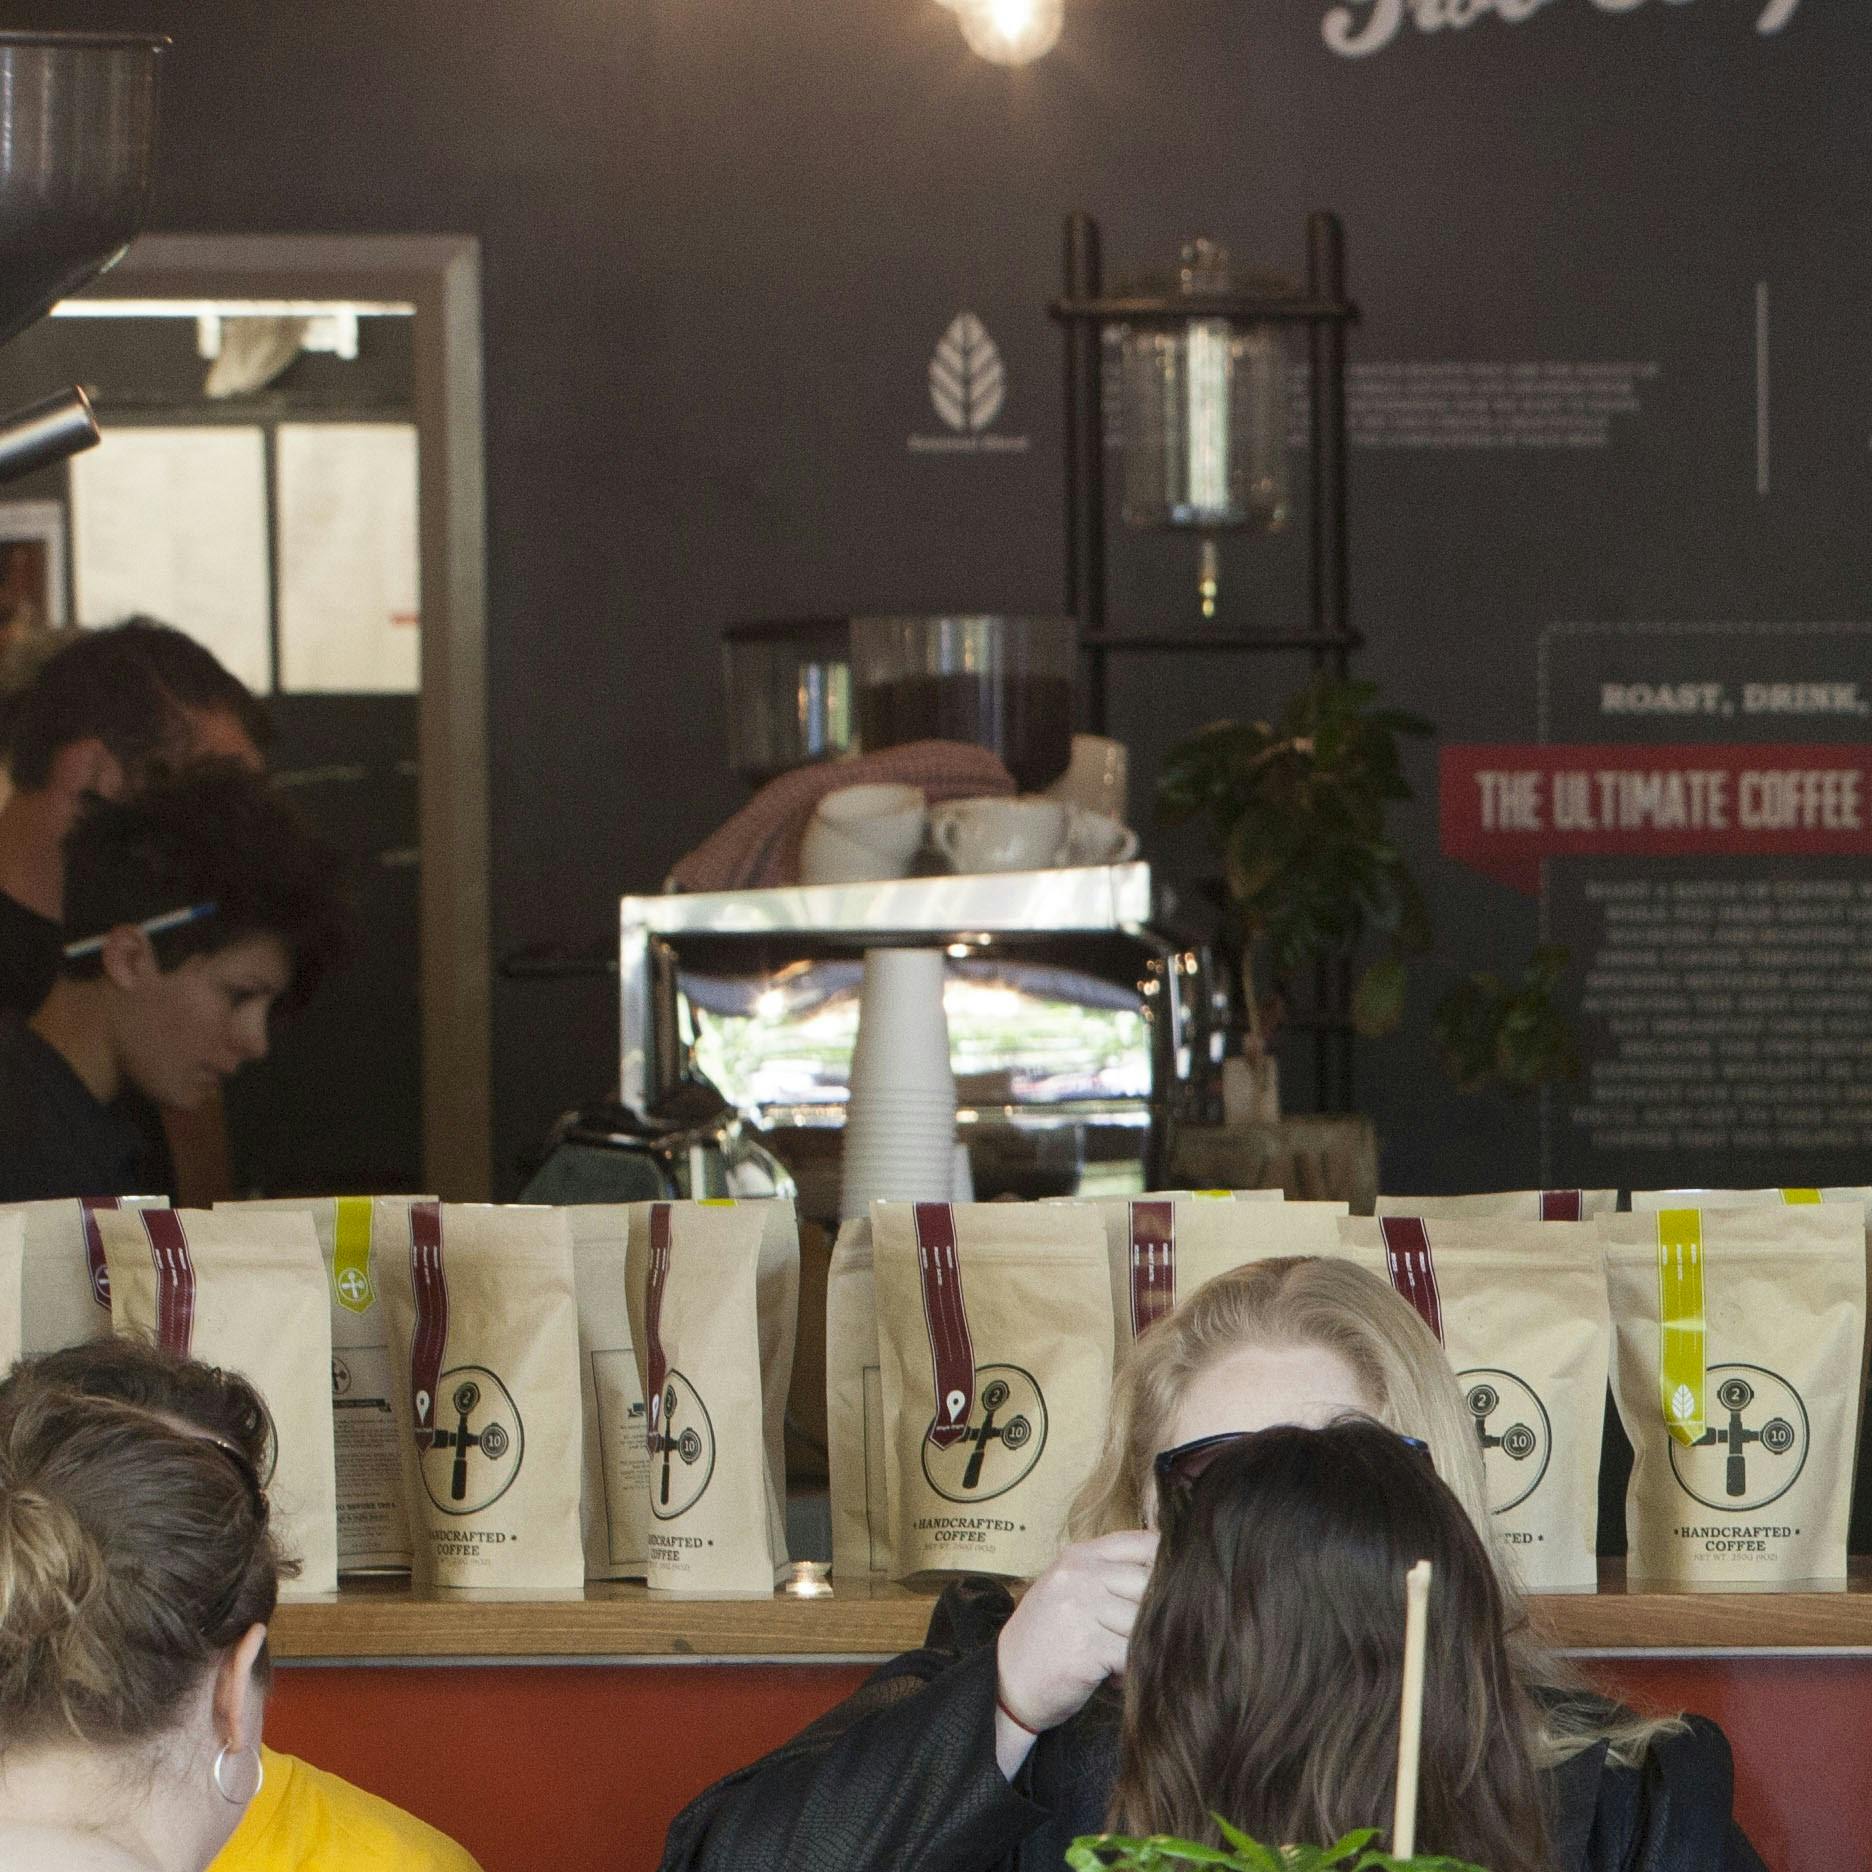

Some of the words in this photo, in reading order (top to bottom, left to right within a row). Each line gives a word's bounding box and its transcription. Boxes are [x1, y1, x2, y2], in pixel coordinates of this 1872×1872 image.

[1601, 682, 1735, 717] ROAST,
[1742, 682, 1871, 717] DRINK,
[1475, 769, 1542, 830] THE
[1552, 769, 1728, 830] ULTIMATE
[1738, 769, 1861, 830] COFFEE
[991, 1388, 1000, 1402] 2
[1731, 1387, 1740, 1400] 2
[1477, 1394, 1488, 1407] 2
[1008, 1426, 1024, 1439] 10
[1770, 1430, 1786, 1442] 10
[486, 1435, 500, 1447] 10
[684, 1439, 696, 1452] 10
[1511, 1435, 1528, 1448] 10
[918, 1517, 1015, 1532] HANDCRAFTED
[429, 1530, 506, 1544] NDCRAFTED
[934, 1530, 986, 1542] COFFEE
[1681, 1526, 1792, 1538] HANDCRAFTED
[436, 1544, 480, 1556] COFFEE
[1705, 1540, 1767, 1552] COFFEE
